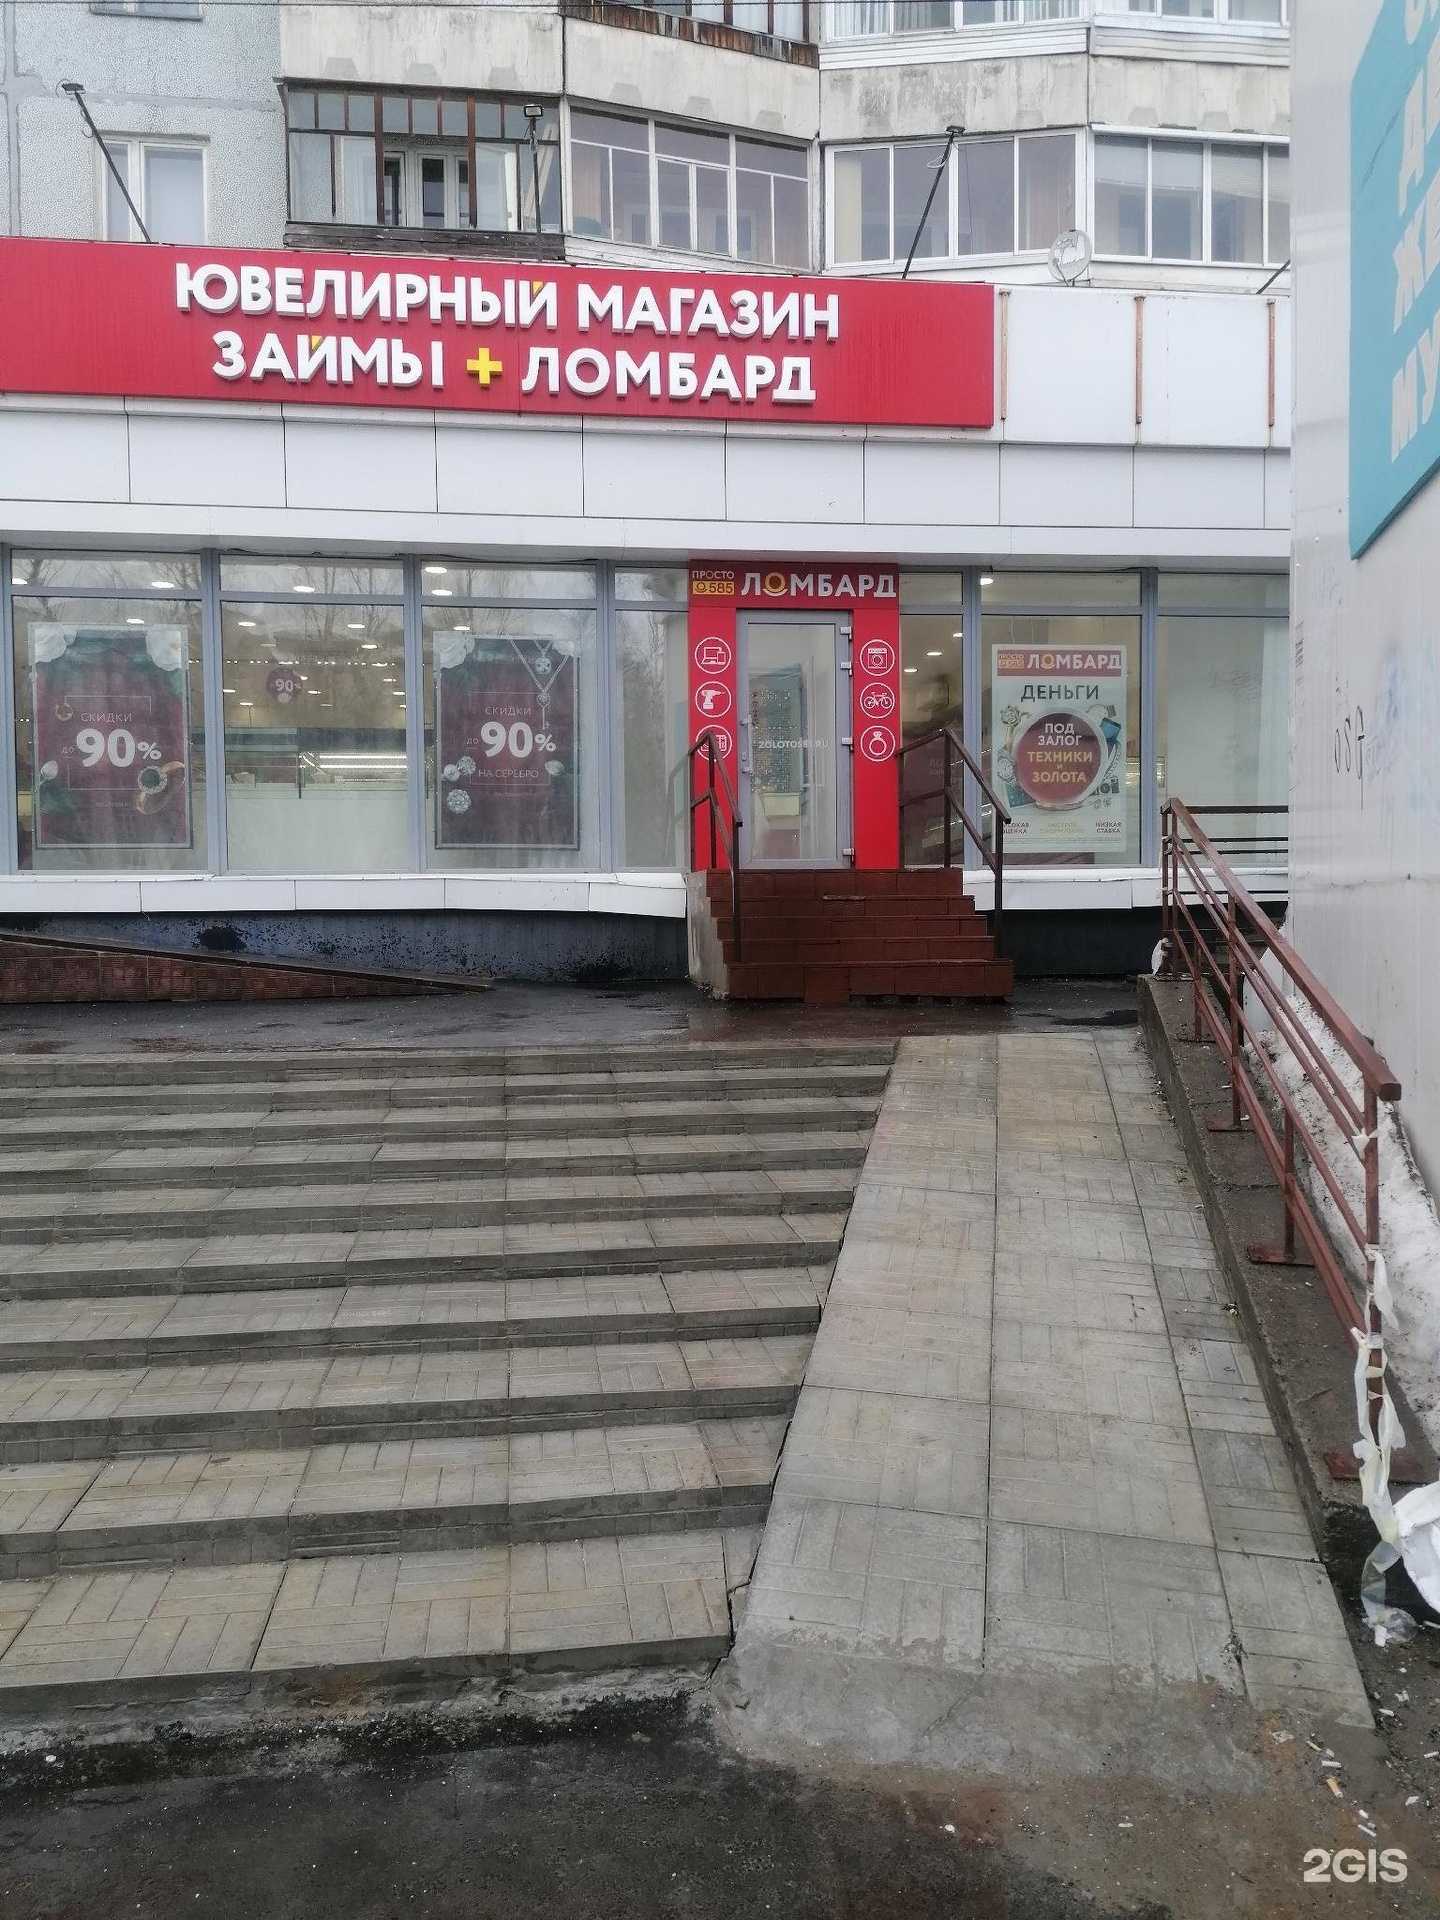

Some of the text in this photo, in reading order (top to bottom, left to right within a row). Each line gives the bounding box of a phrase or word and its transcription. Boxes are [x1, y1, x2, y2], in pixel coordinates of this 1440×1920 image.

[175, 262, 840, 341] ЮВЕЛИРНЫЙ МАГАЗИН
[211, 331, 445, 388] ЗАЙМЫ
[520, 347, 818, 403] ЛОМБАРД
[692, 570, 735, 580] ПРОСТО
[741, 572, 897, 598] ЛОМБАРД
[1027, 654, 1122, 670] ЛОМБАРД
[1021, 684, 1099, 702] ДЕНЬГИ
[485, 706, 532, 717] СКИДКИ
[81, 712, 132, 724] СКИДКИ
[1045, 723, 1075, 735] ПОД
[480, 721, 557, 759] 90%
[1038, 735, 1082, 746] ЗАЛОГ
[76, 728, 163, 768] 90%
[1027, 751, 1093, 763] ТЕХНИКИ
[478, 770, 493, 778] НА
[1032, 771, 1088, 783] ЗОЛОТА
